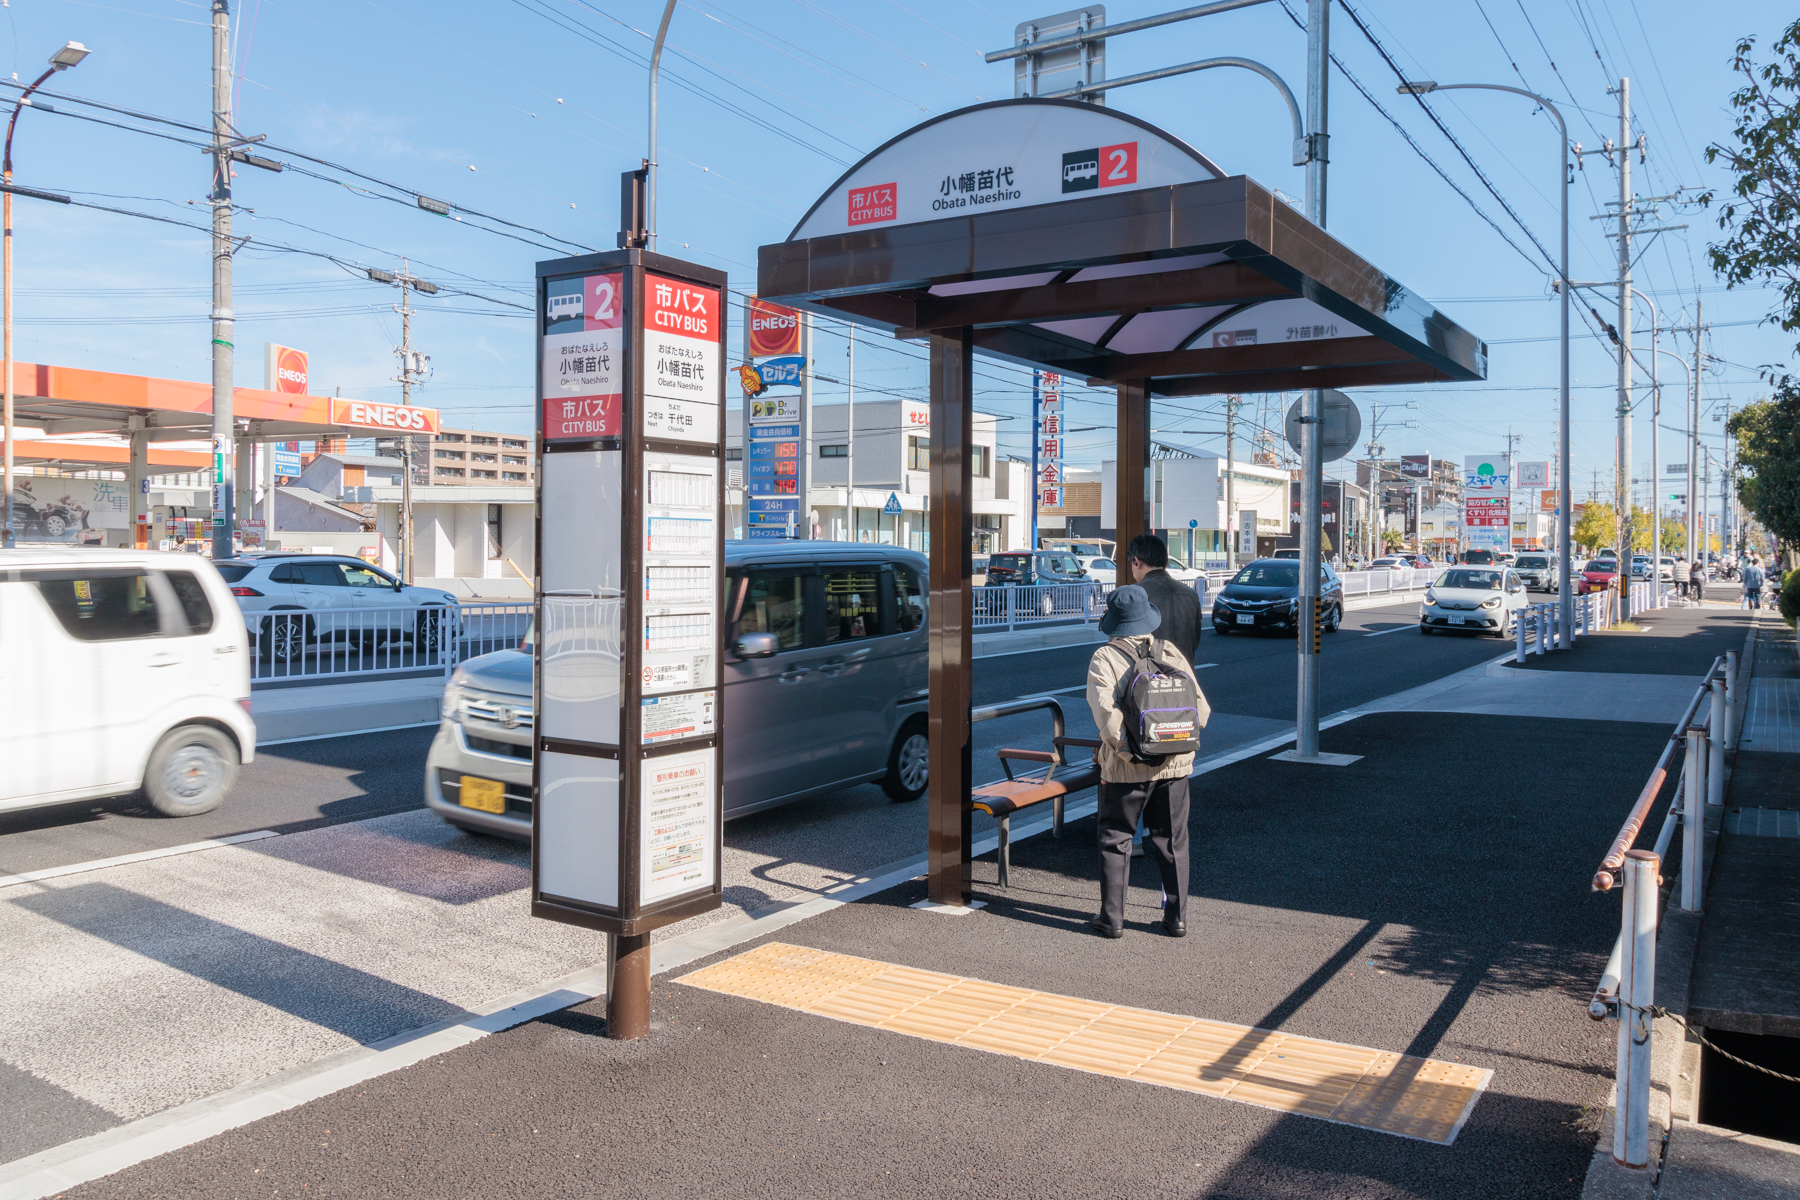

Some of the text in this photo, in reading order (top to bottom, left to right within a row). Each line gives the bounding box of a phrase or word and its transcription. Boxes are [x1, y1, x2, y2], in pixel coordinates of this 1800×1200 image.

[1107, 150, 1128, 180] 2
[940, 166, 1014, 196] 小幡苗代
[852, 188, 892, 209] 市バス
[932, 188, 1021, 211] Obata Naeshiro
[851, 206, 893, 221] CITY BUS
[594, 282, 614, 320] 2
[655, 284, 707, 315] 市バス
[655, 310, 707, 334] CITY BUS
[752, 315, 796, 331] ENEOS
[560, 342, 609, 355] おばたなえしろ
[658, 344, 704, 360] おばたなえしろ
[560, 356, 610, 375] 小幡苗代
[657, 358, 704, 380] 小幡苗代
[762, 364, 798, 382] セルフ
[278, 368, 306, 384] ENEOS
[560, 376, 609, 387] Obata Naeshiro
[658, 378, 703, 392] Obata Naeshiro
[351, 403, 424, 429] ENEOS
[562, 400, 605, 419] 市バス
[562, 420, 606, 434] CITY BUS
[648, 412, 693, 426] つぎは 千代田
[757, 428, 792, 436] 現金会員価格
[780, 443, 797, 457] 159
[780, 461, 796, 475] 170
[144, 480, 149, 492] 3
[779, 480, 796, 494] 140
[765, 501, 782, 510] 24H
